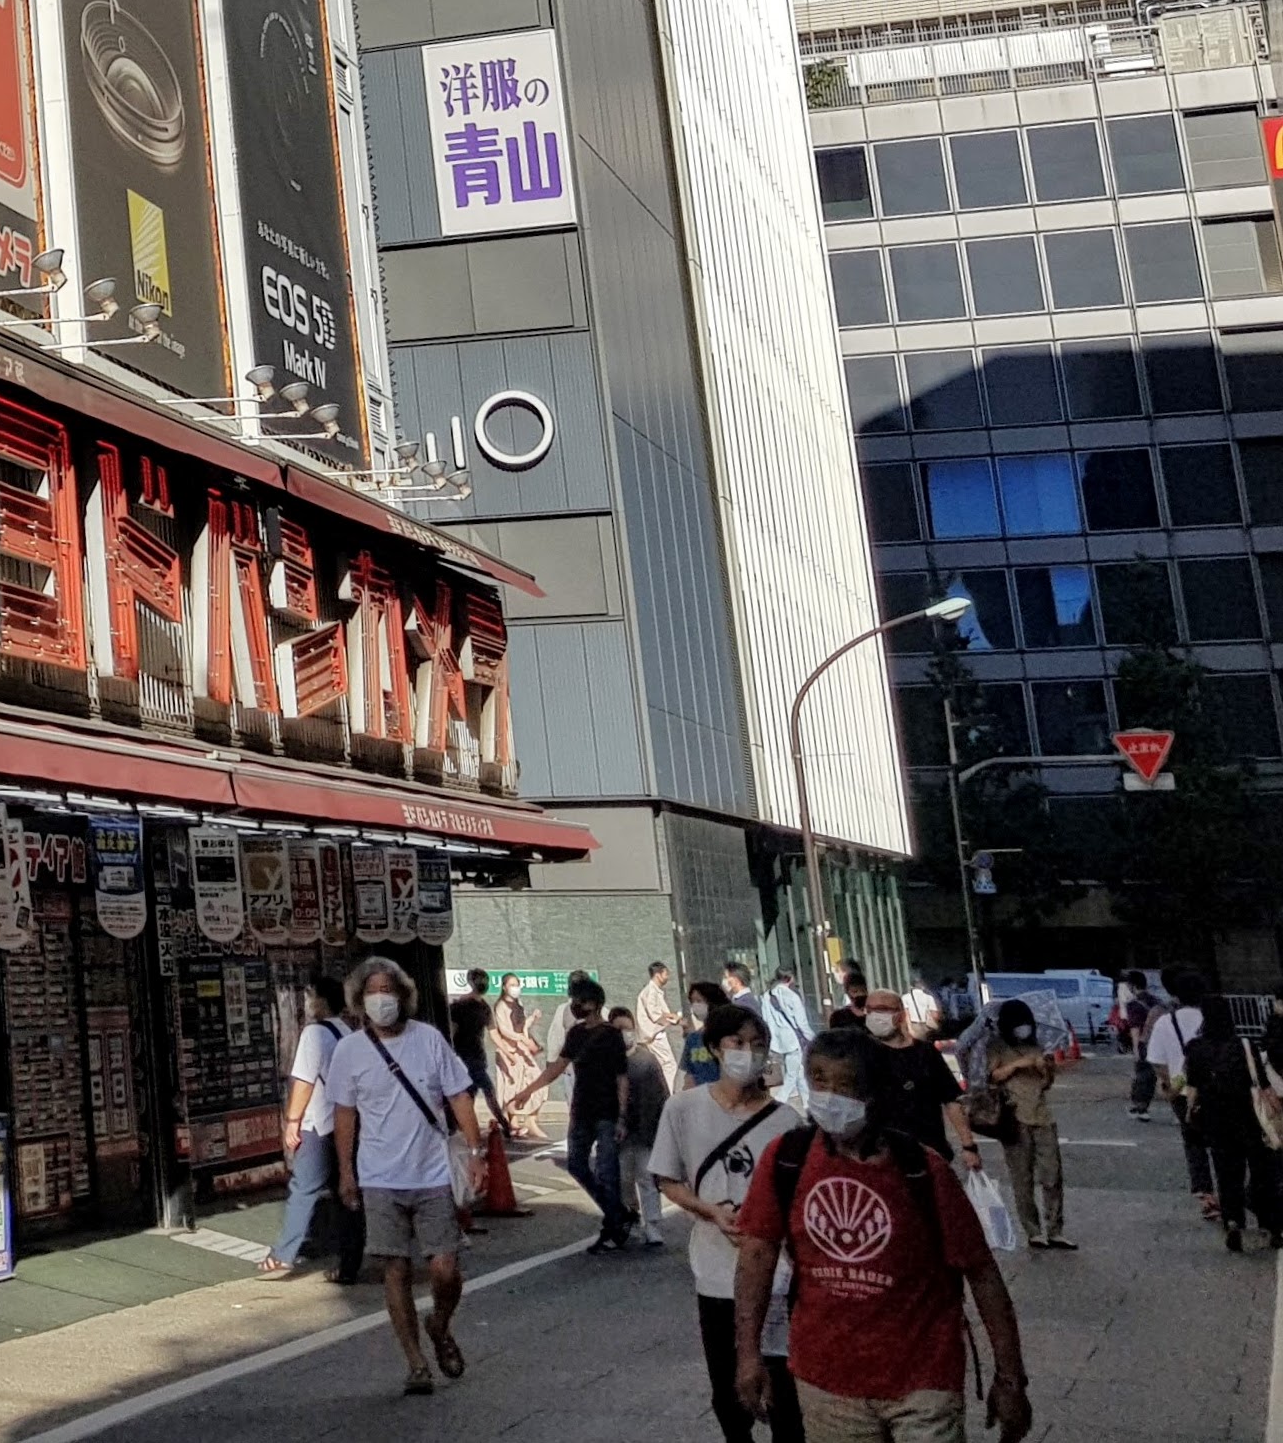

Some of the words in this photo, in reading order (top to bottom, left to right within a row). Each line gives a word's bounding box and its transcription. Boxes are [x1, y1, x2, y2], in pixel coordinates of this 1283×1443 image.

[439, 57, 551, 119] 洋服の
[444, 119, 563, 209] 青山
[135, 270, 171, 314] Nikon
[262, 265, 310, 336] EOS
[283, 338, 314, 385] Mark
[315, 360, 328, 390] IV
